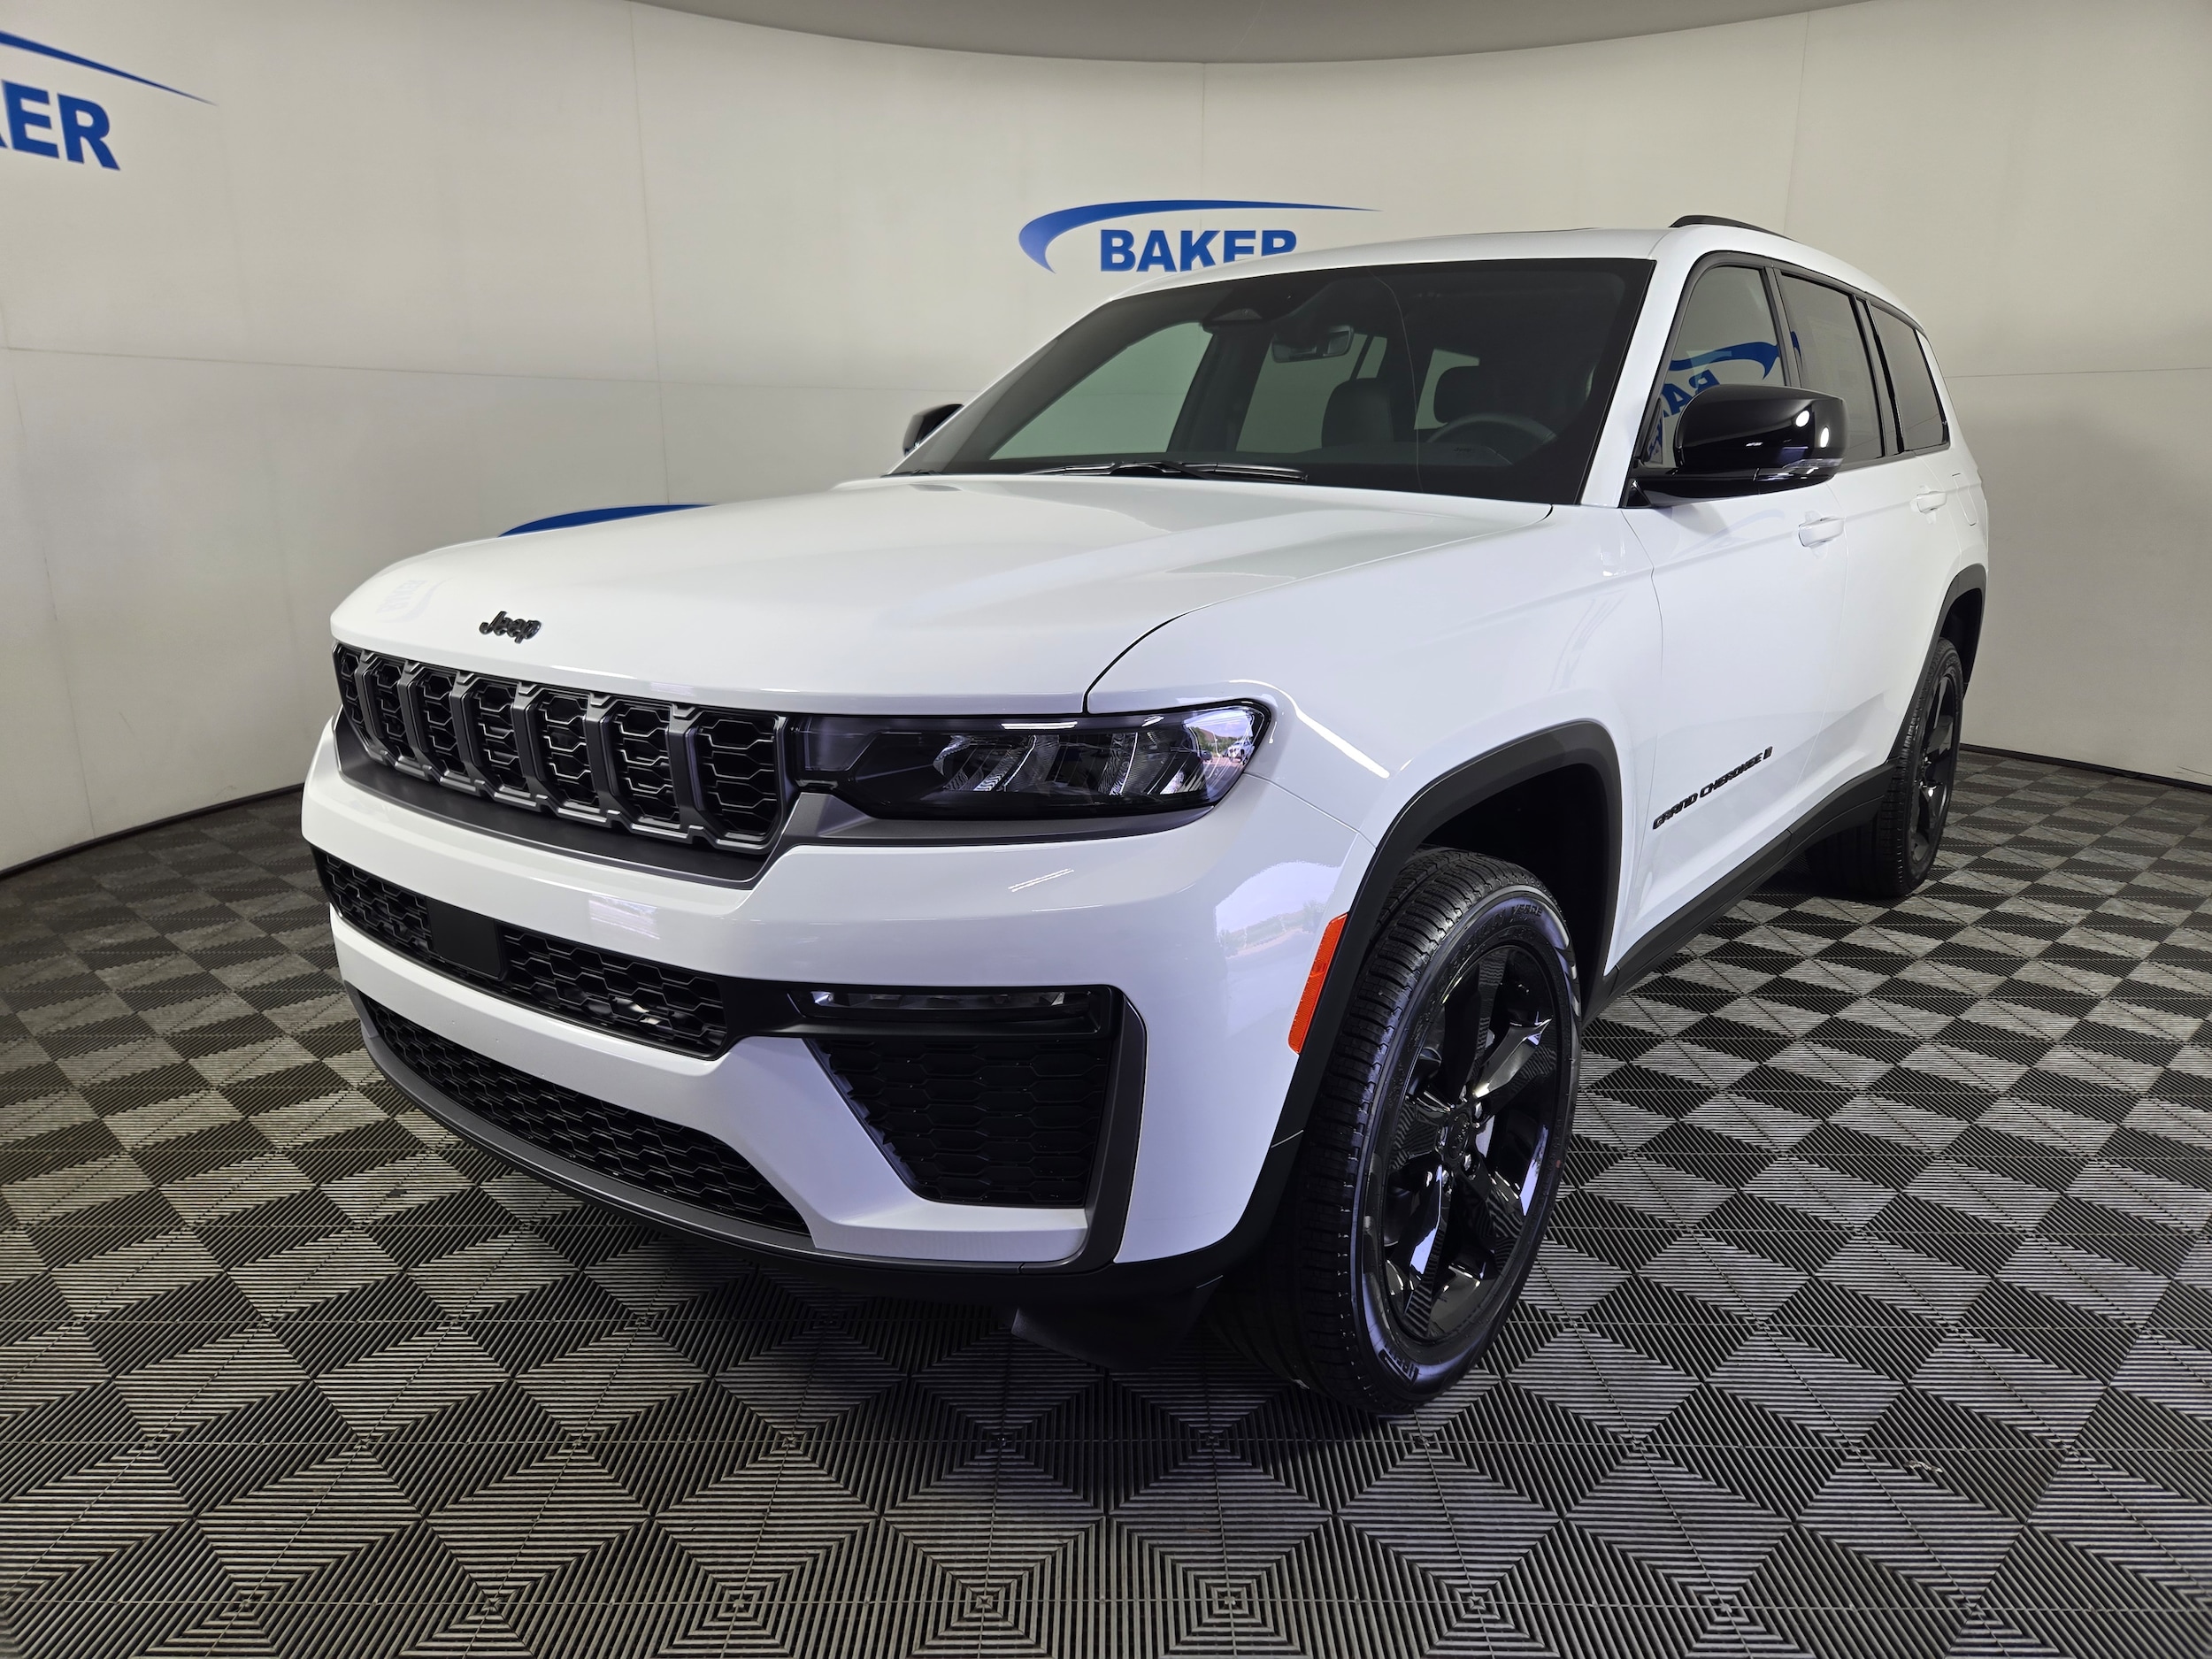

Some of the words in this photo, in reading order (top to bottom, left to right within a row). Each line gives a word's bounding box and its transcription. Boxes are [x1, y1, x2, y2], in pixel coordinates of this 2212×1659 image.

[0, 80, 120, 171] ER
[479, 611, 541, 644] Jeep
[1652, 793, 1699, 830] GRAND
[1700, 752, 1763, 798] CHEROKEE
